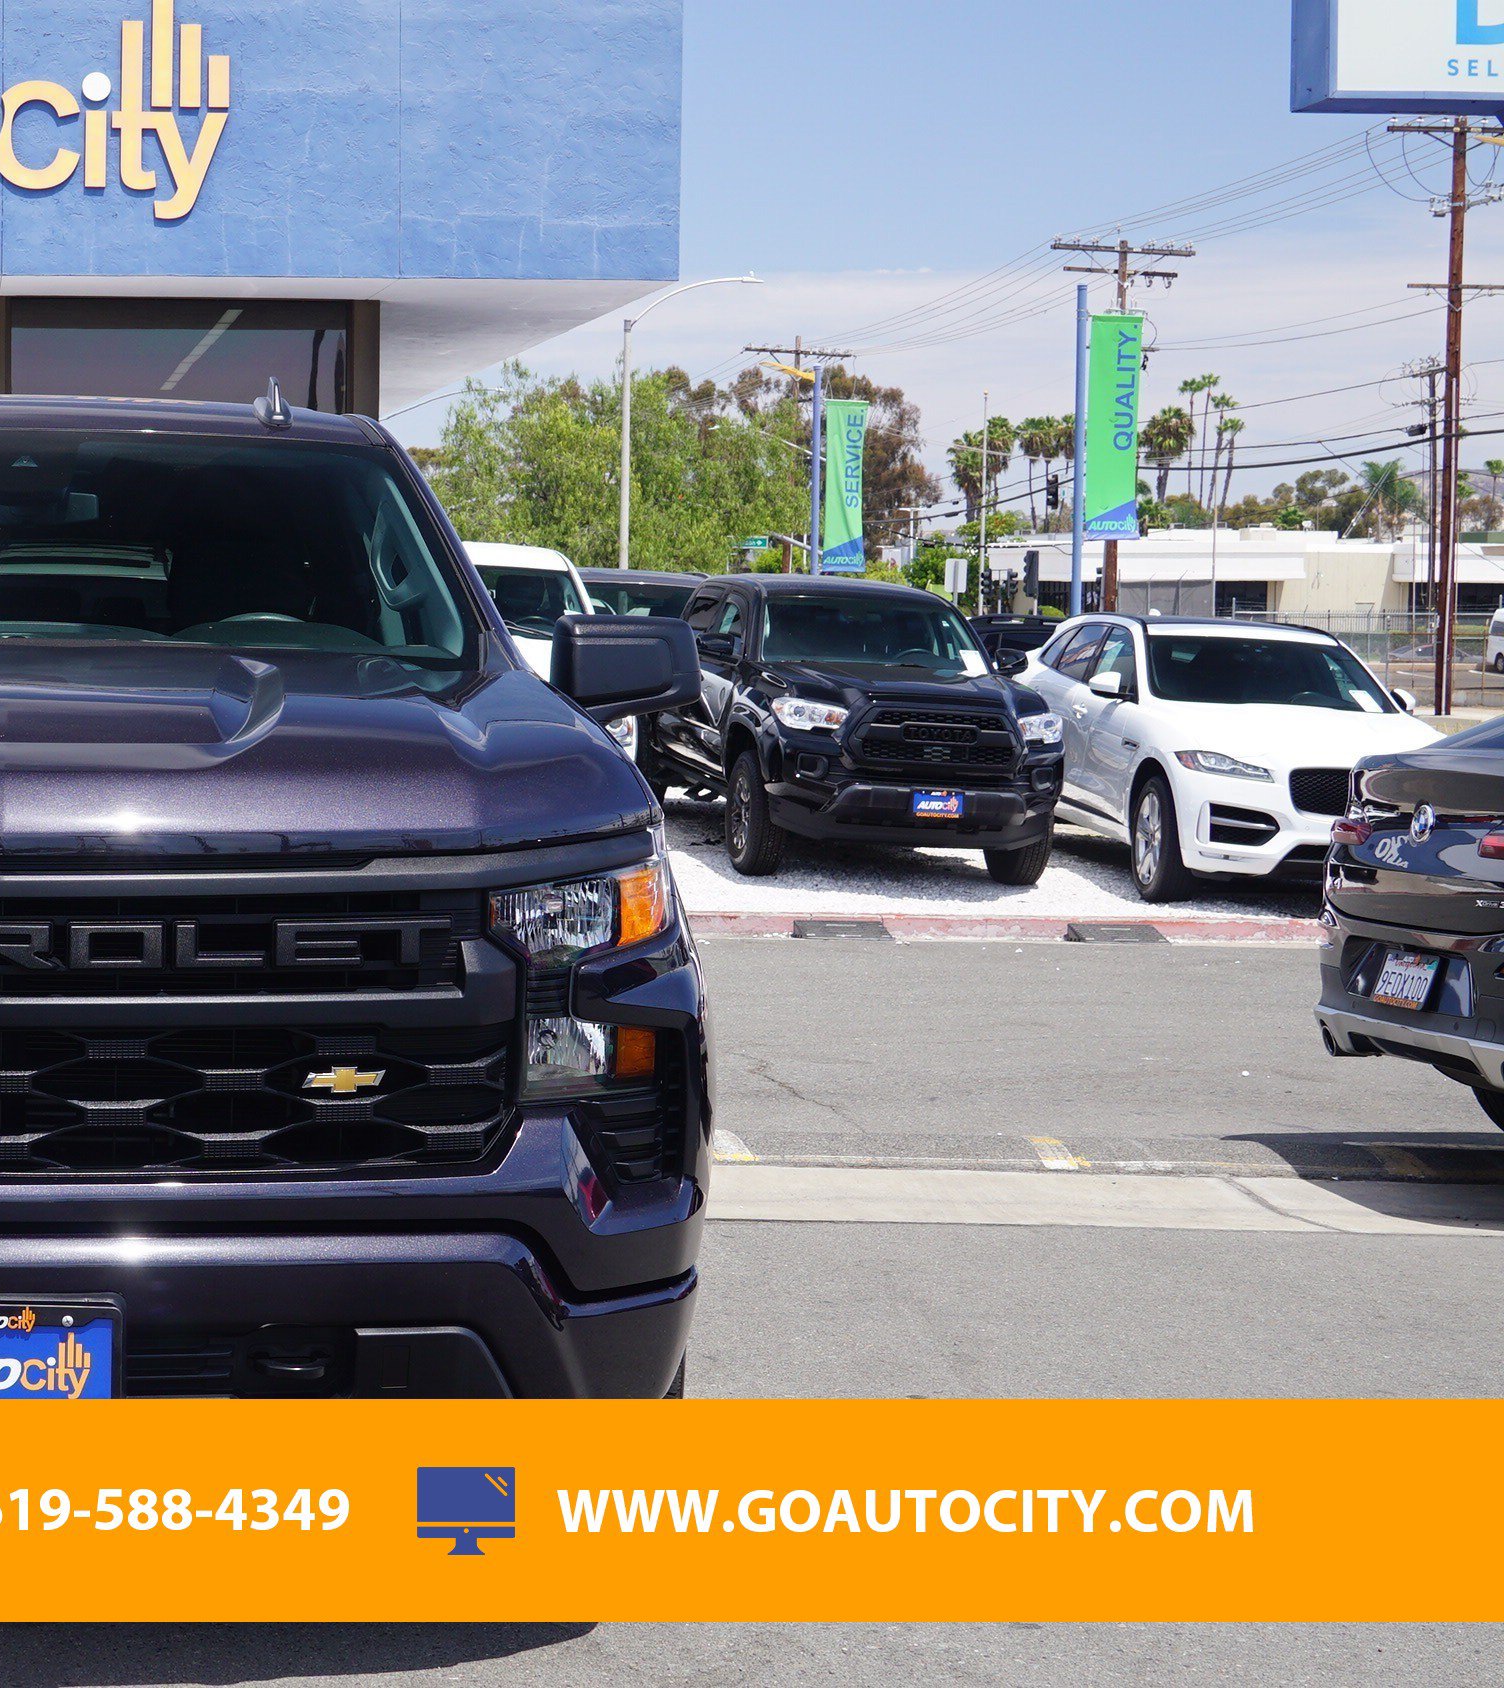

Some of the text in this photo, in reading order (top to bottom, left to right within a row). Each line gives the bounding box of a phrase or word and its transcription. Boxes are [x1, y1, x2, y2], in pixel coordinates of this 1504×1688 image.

[1113, 324, 1139, 450] QUALITY.
[844, 409, 865, 508] SERVICE.
[908, 726, 973, 740] TOYOTA
